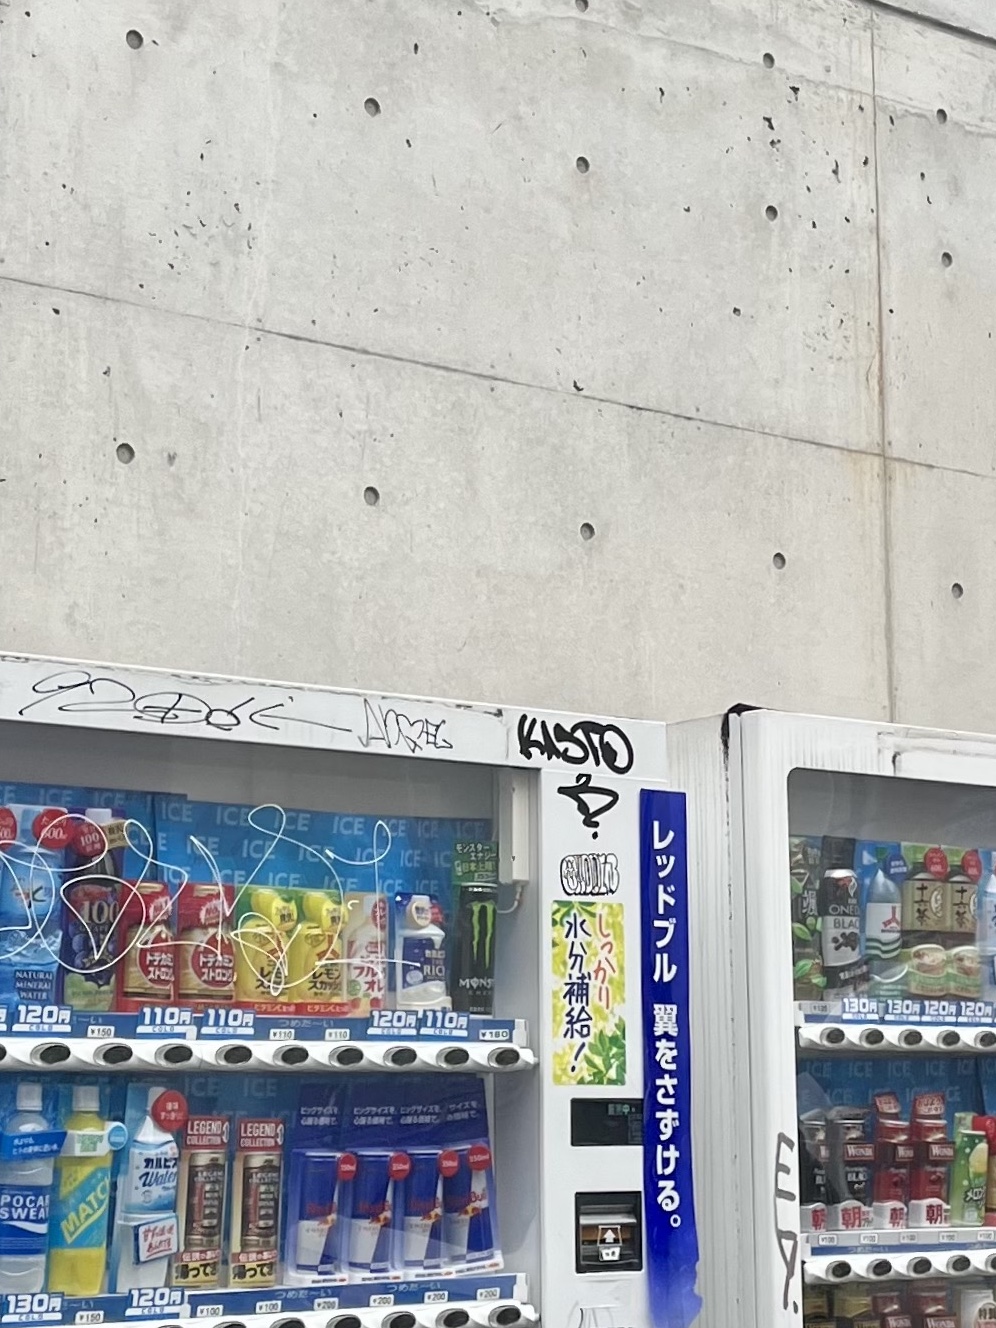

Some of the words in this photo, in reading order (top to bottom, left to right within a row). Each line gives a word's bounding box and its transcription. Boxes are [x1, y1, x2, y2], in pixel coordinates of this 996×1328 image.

[161, 803, 193, 823] ICE
[333, 816, 365, 836] ICE
[651, 819, 678, 984] レッドブル
[594, 912, 616, 1010] しっかり
[18, 1005, 71, 1024] 120円
[842, 998, 878, 1014] 130円
[887, 1000, 920, 1015] 130円
[923, 1000, 957, 1016] 120円
[960, 1001, 992, 1016] 120円
[143, 1007, 193, 1025] 110円
[207, 1008, 255, 1026] 110円
[371, 1010, 417, 1027] 120円
[426, 1011, 468, 1028] 110円
[653, 1003, 682, 1228] 翼をさずける。
[187, 1120, 223, 1136] LEGEND
[241, 1122, 275, 1137] LEGEND
[926, 1204, 944, 1226] 朝
[8, 1294, 62, 1313] 130円
[131, 1289, 182, 1307] 120円
